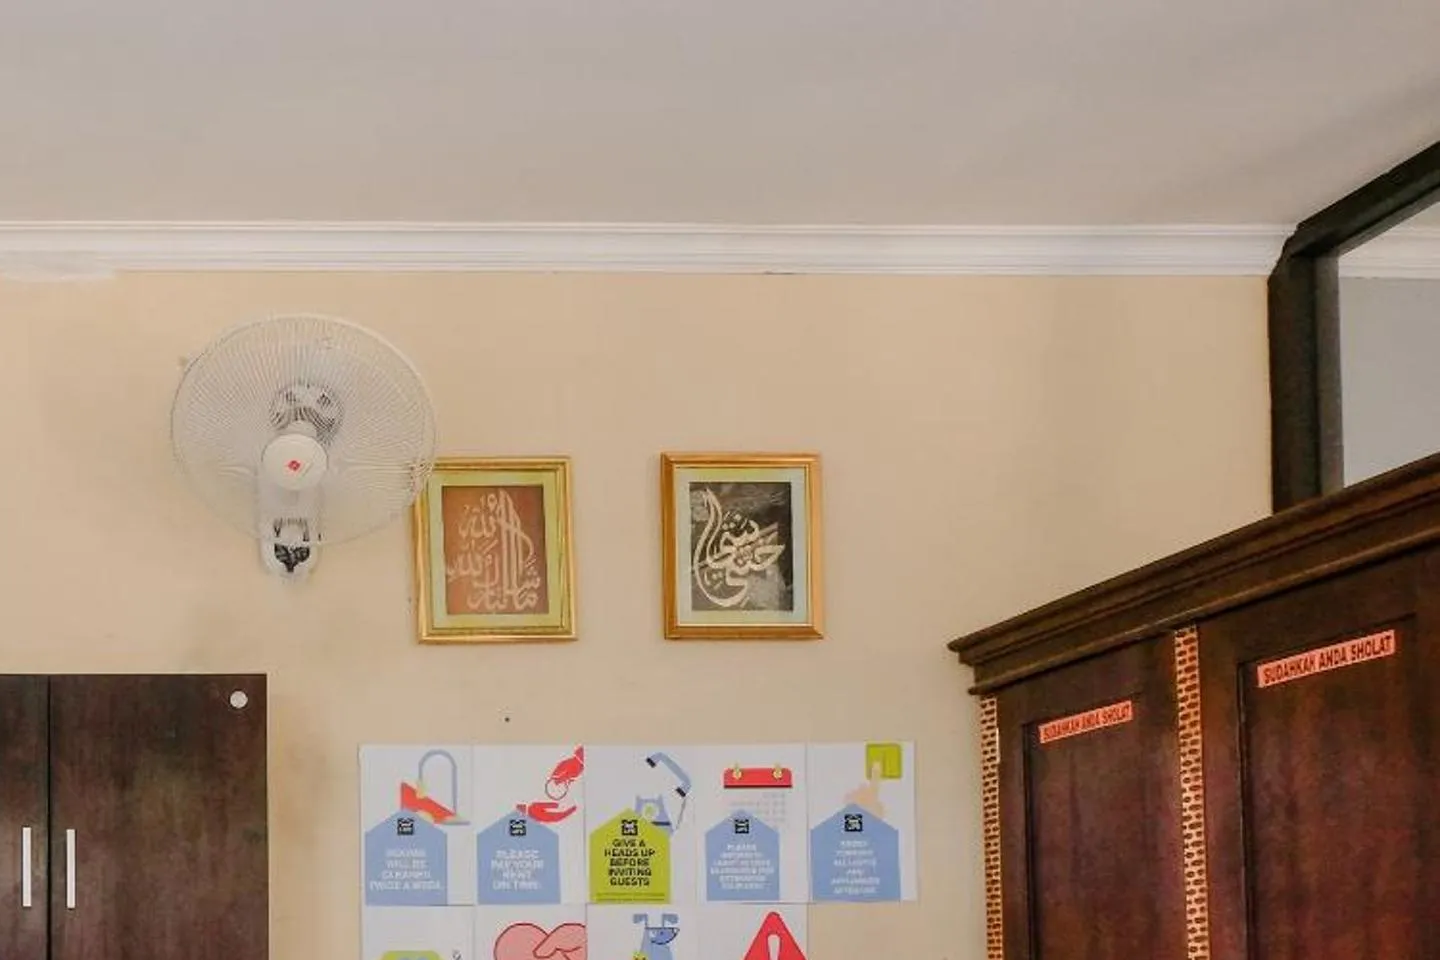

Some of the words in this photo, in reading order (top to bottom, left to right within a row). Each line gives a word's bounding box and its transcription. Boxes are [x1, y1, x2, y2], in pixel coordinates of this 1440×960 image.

[1262, 653, 1318, 685] SUDAHKAH
[1319, 646, 1348, 669] ANDA
[1350, 634, 1392, 662] SHOLAT
[1102, 703, 1131, 725] SHOLAT
[612, 838, 637, 848] GIVE
[639, 838, 646, 848] A
[604, 848, 638, 857] HEADS
[640, 848, 656, 857] UP
[610, 858, 650, 867] BEFORE
[608, 867, 652, 876] INVITING
[610, 877, 650, 887] GUESTS
